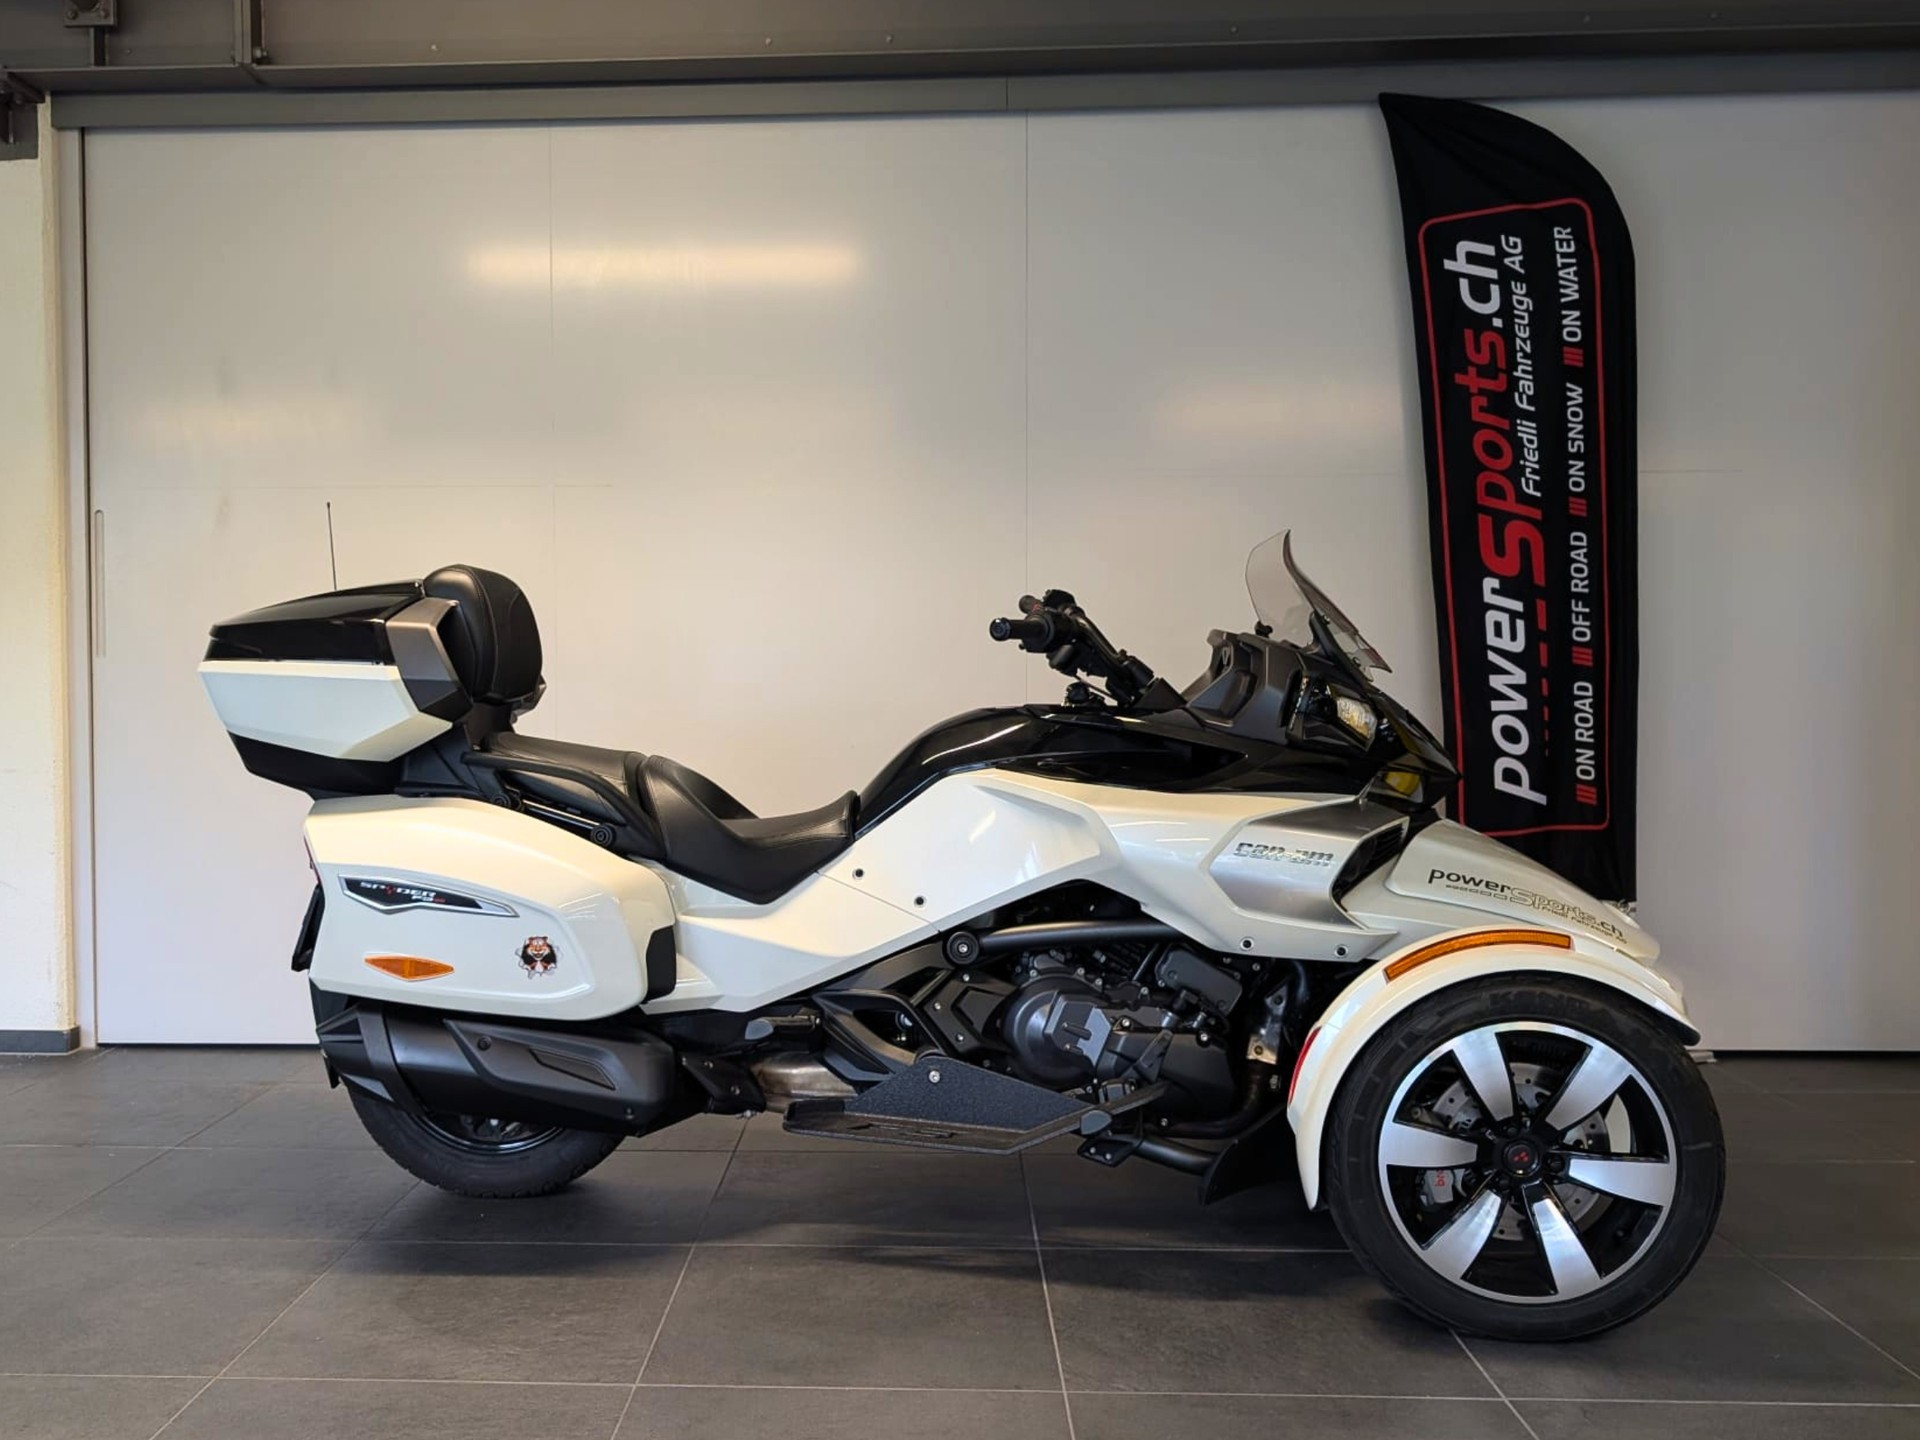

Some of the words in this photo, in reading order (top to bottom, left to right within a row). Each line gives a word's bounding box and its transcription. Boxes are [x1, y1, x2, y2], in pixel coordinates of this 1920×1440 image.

[1501, 234, 1525, 274] AG
[1553, 226, 1580, 303] WATER
[1510, 281, 1537, 412] Fahrzeuge
[1561, 310, 1582, 342] ON
[1565, 383, 1585, 453] SNOW
[1517, 419, 1542, 497] Friedli
[1568, 459, 1586, 492] ON
[1443, 240, 1547, 806] powerSports.ch
[1570, 531, 1589, 593] ROAD
[1571, 599, 1591, 642] OFF
[1573, 681, 1595, 743] ROAD
[1576, 748, 1596, 781] ON
[1428, 868, 1624, 938] powerSports.ch
